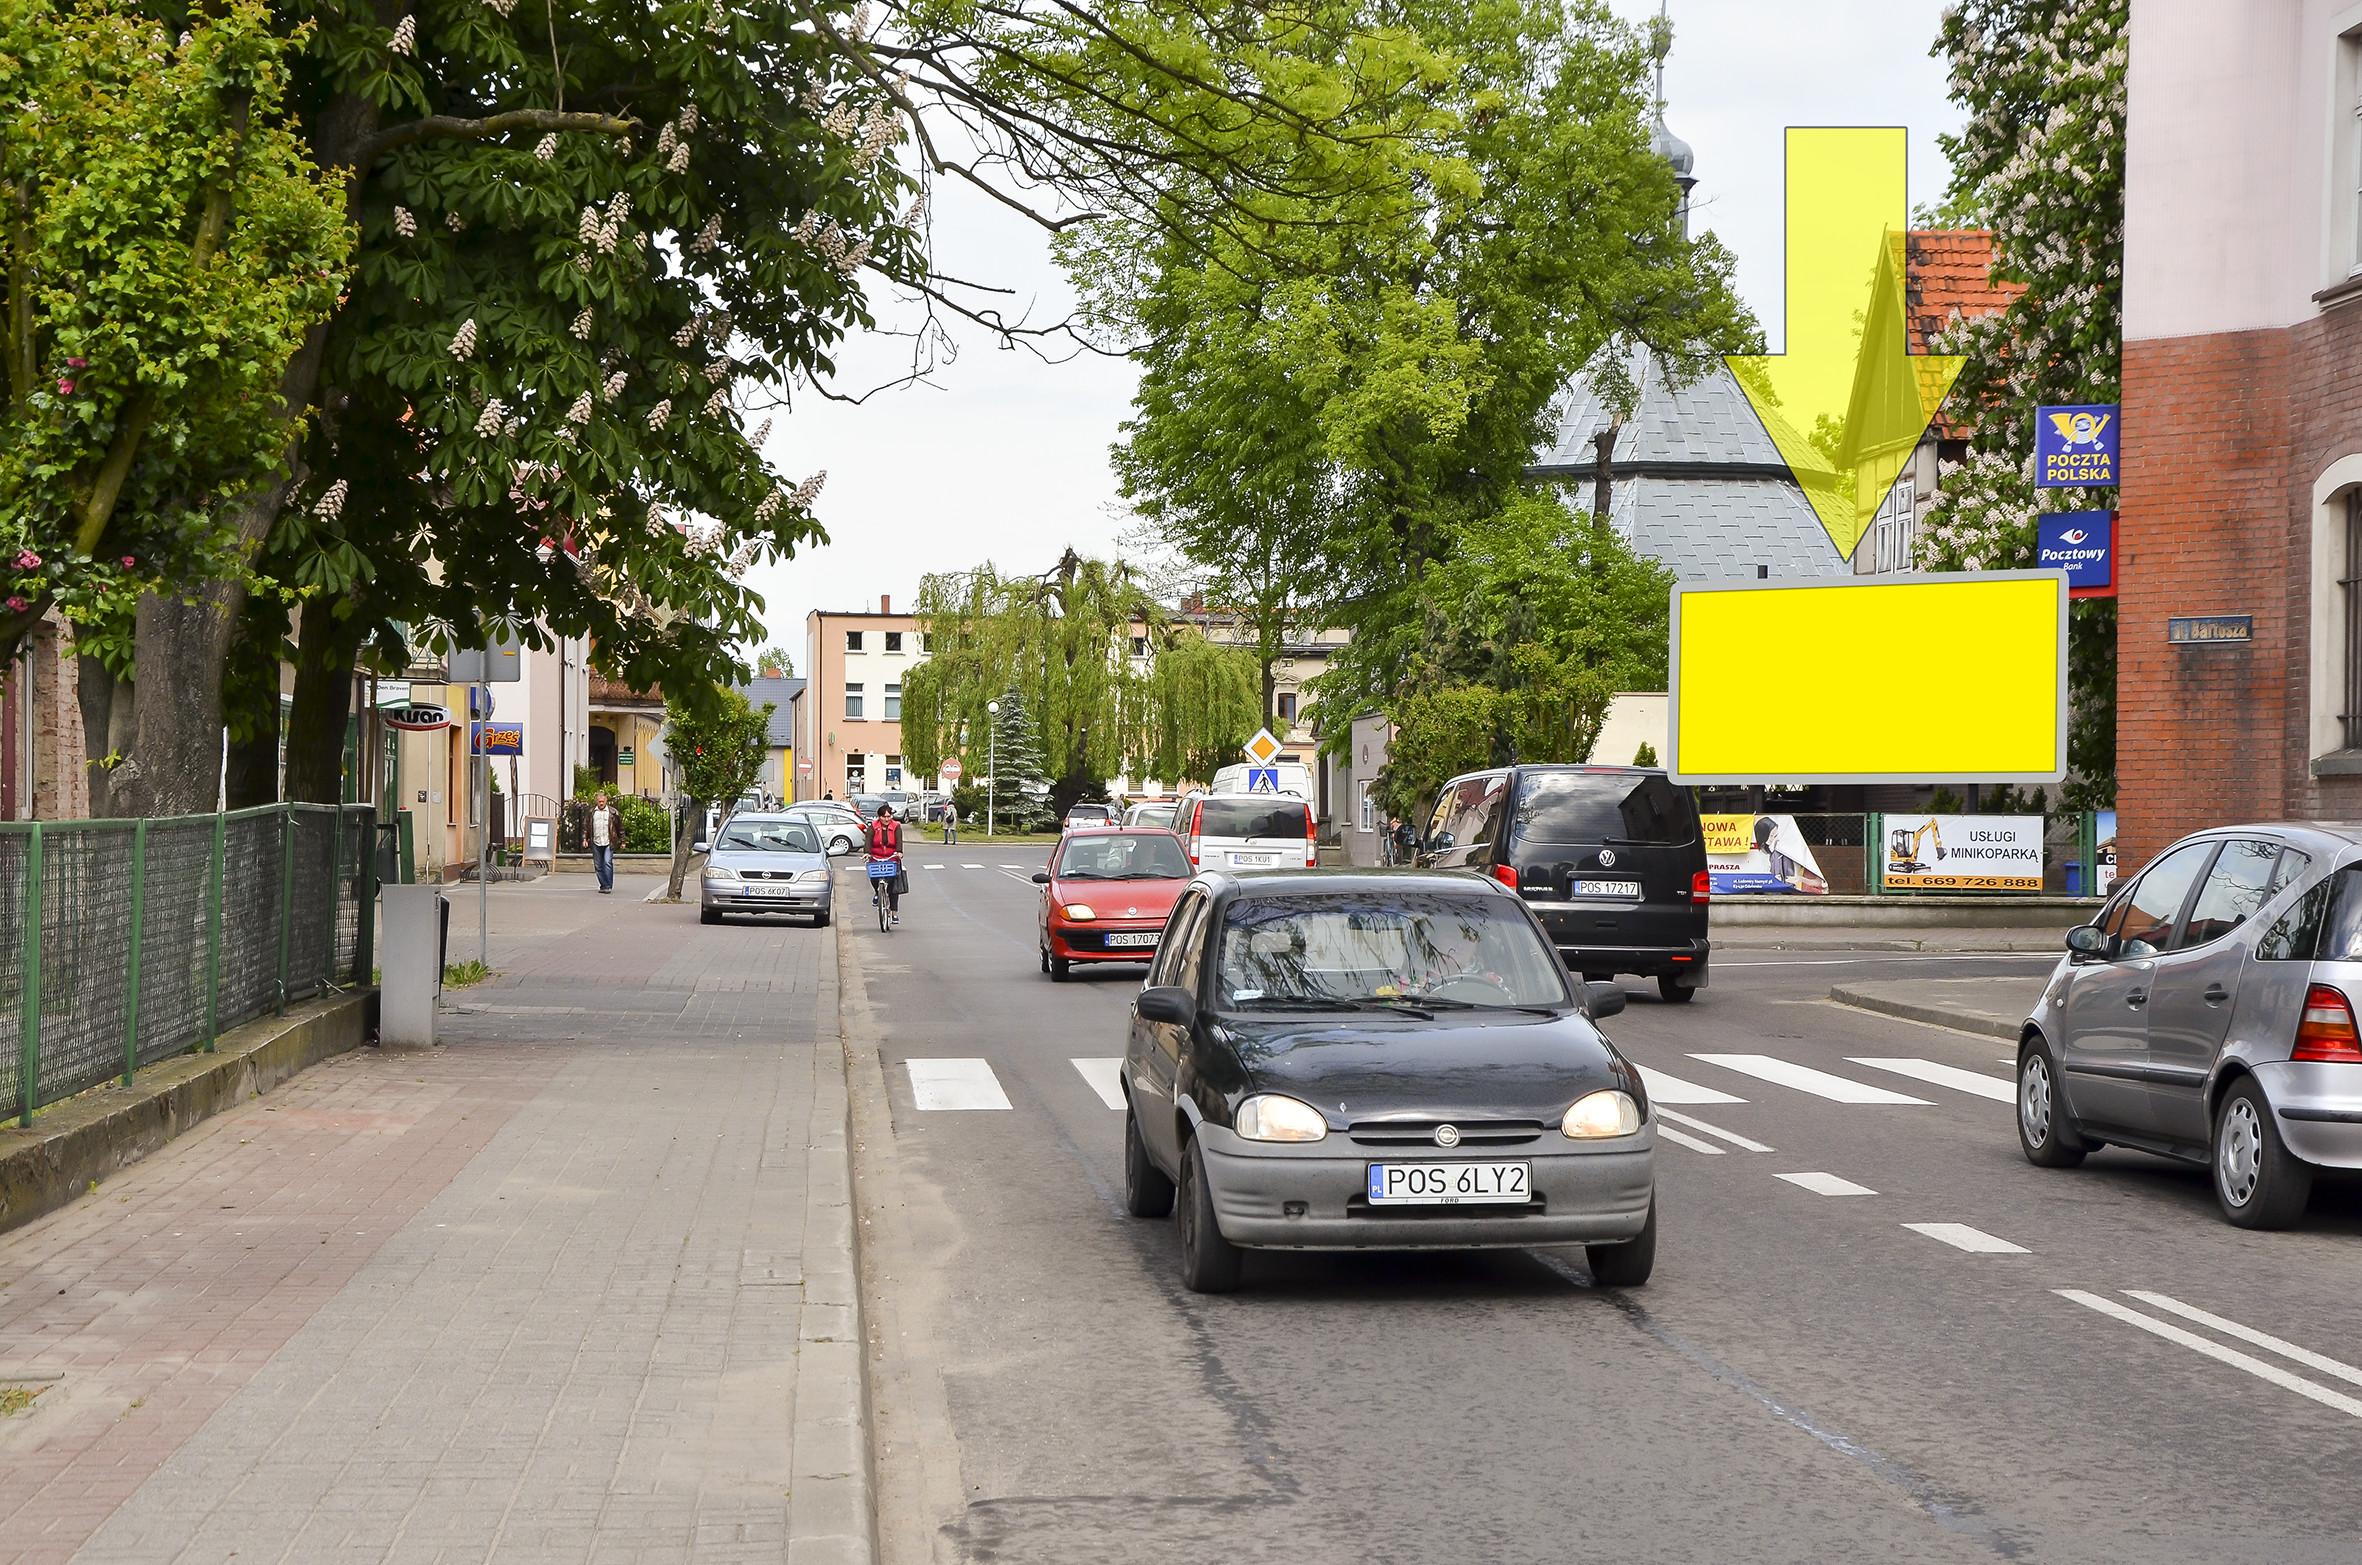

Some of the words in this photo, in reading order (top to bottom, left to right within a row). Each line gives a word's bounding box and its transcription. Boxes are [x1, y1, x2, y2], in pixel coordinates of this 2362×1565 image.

[2047, 454, 2111, 466] POCZTA
[2047, 468, 2111, 480] POLSKA
[2041, 548, 2106, 562] Pocztowy
[2063, 562, 2084, 571] Bank
[1704, 836, 1741, 847] TAWA
[1969, 831, 2016, 843] USŁUGI
[1238, 855, 1253, 863] POS
[1951, 848, 2039, 863] MINIKOPARKĄ
[1580, 882, 1601, 893] POS
[1606, 882, 1636, 894] 17217
[1888, 877, 1916, 885] tel.
[1922, 877, 1957, 885] 669
[1963, 878, 1998, 886] 726
[2003, 879, 2039, 887] 888
[1110, 935, 1129, 944] POS
[1132, 934, 1160, 944] 17073
[1388, 1168, 1447, 1194] POS
[1457, 1167, 1524, 1193] 6LY2
